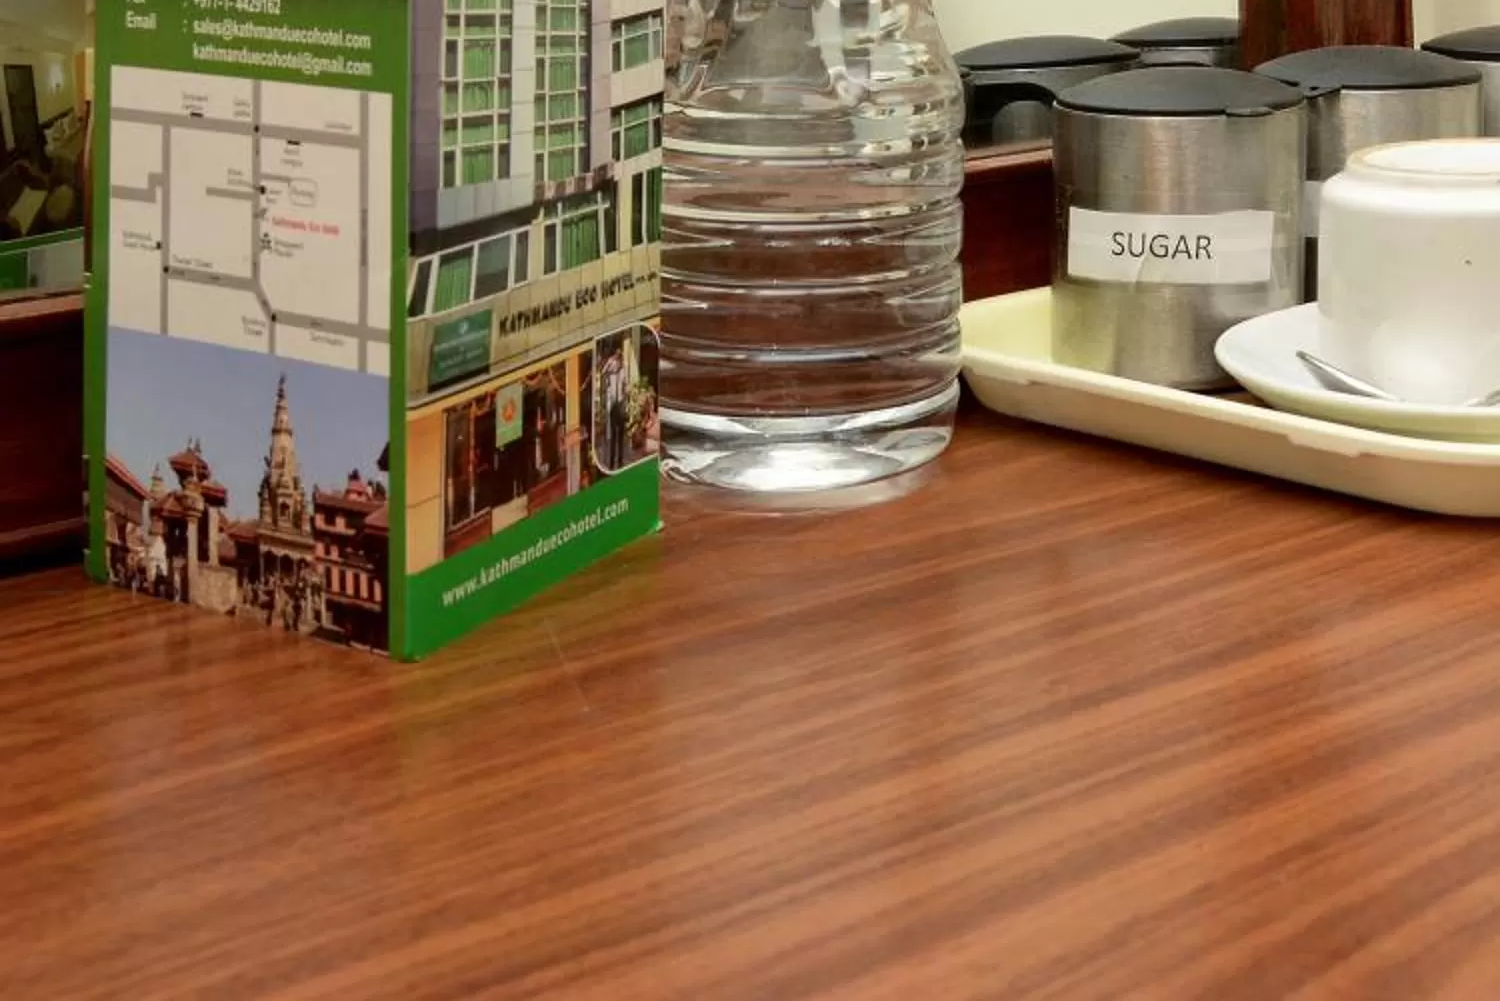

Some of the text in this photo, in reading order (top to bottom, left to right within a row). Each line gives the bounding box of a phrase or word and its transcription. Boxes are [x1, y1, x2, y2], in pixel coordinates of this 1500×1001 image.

[125, 11, 157, 30] Email
[193, 18, 371, 49] sales@kathmanduecohotel.com
[193, 42, 373, 77] kathmanduecohotel@gmail.com
[1111, 231, 1212, 260] SUGAR
[442, 497, 629, 607] www.kathmanduecohotel.com
